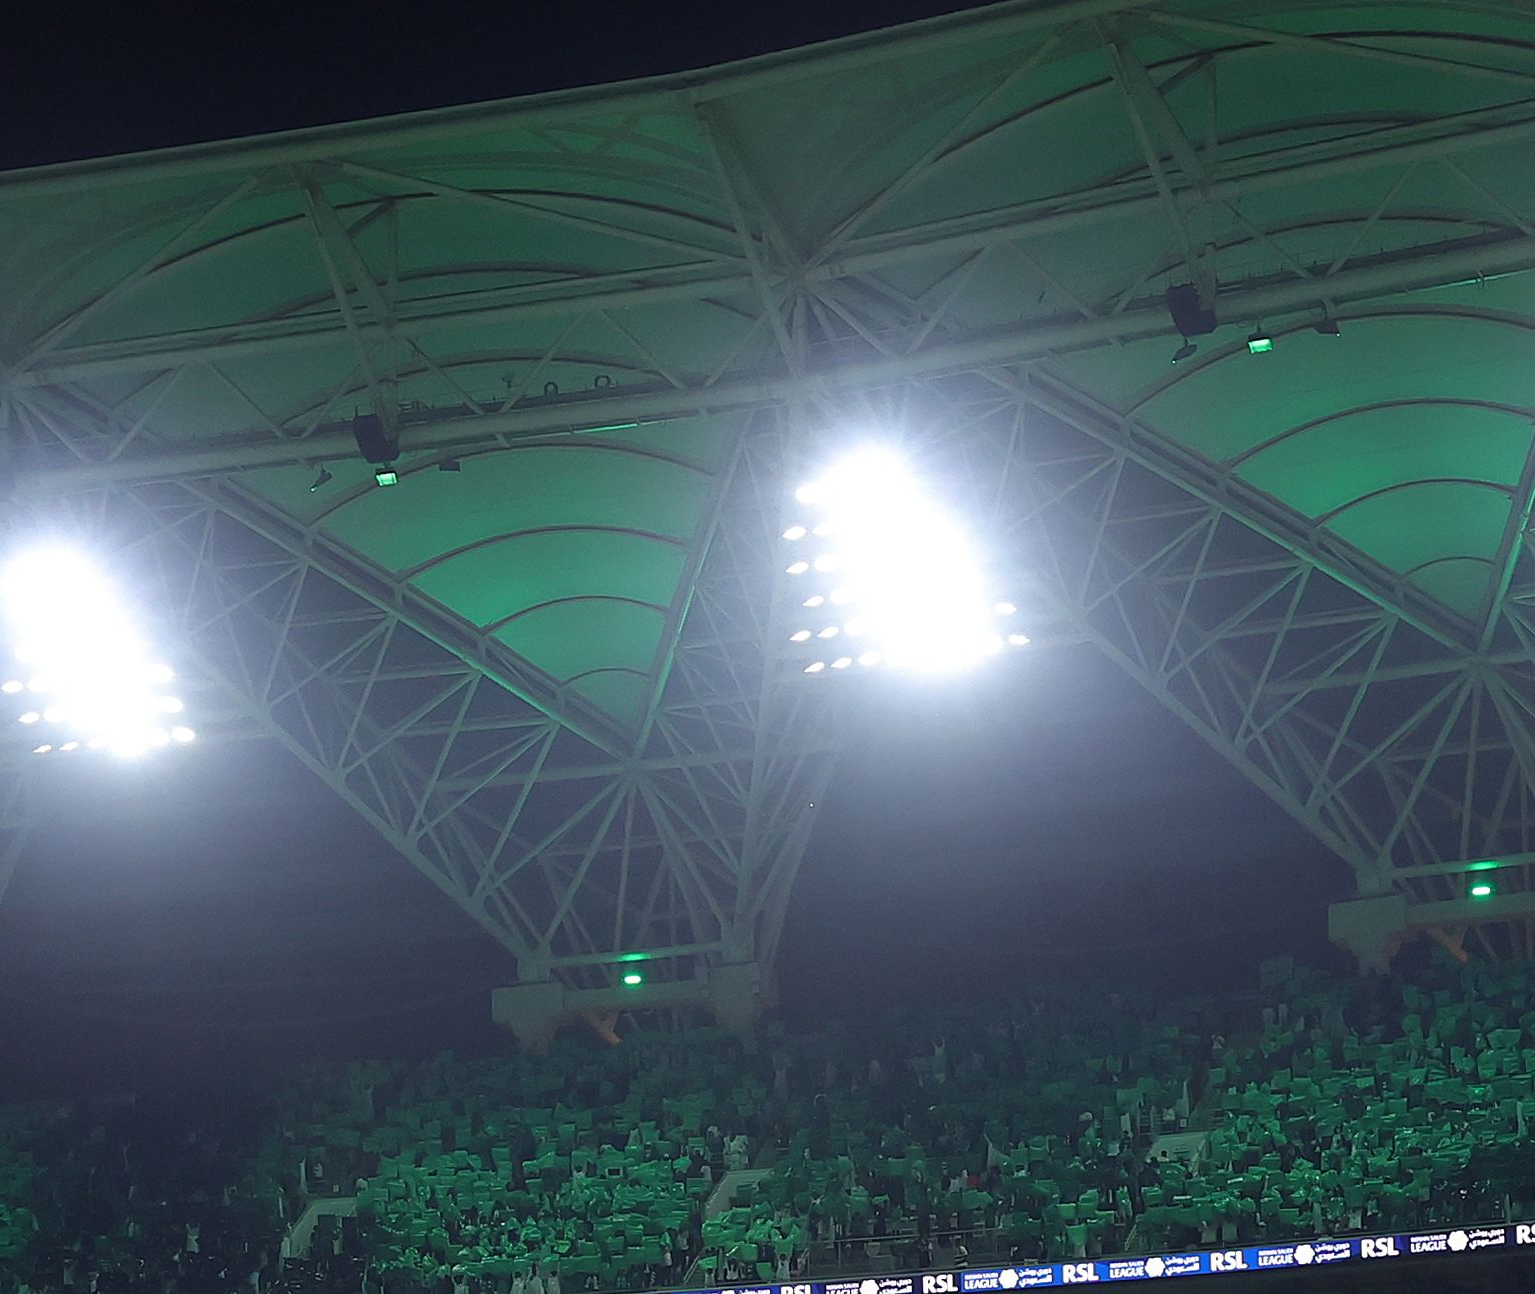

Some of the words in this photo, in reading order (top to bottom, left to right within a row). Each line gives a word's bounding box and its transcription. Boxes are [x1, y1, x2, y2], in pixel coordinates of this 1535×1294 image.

[1361, 1235, 1400, 1258] RSL
[1410, 1239, 1448, 1253] LEAGUE
[1210, 1249, 1248, 1271] RSL
[1258, 1253, 1295, 1266] LEAGUE
[1062, 1262, 1100, 1283] RSL
[922, 1273, 958, 1294] RSL
